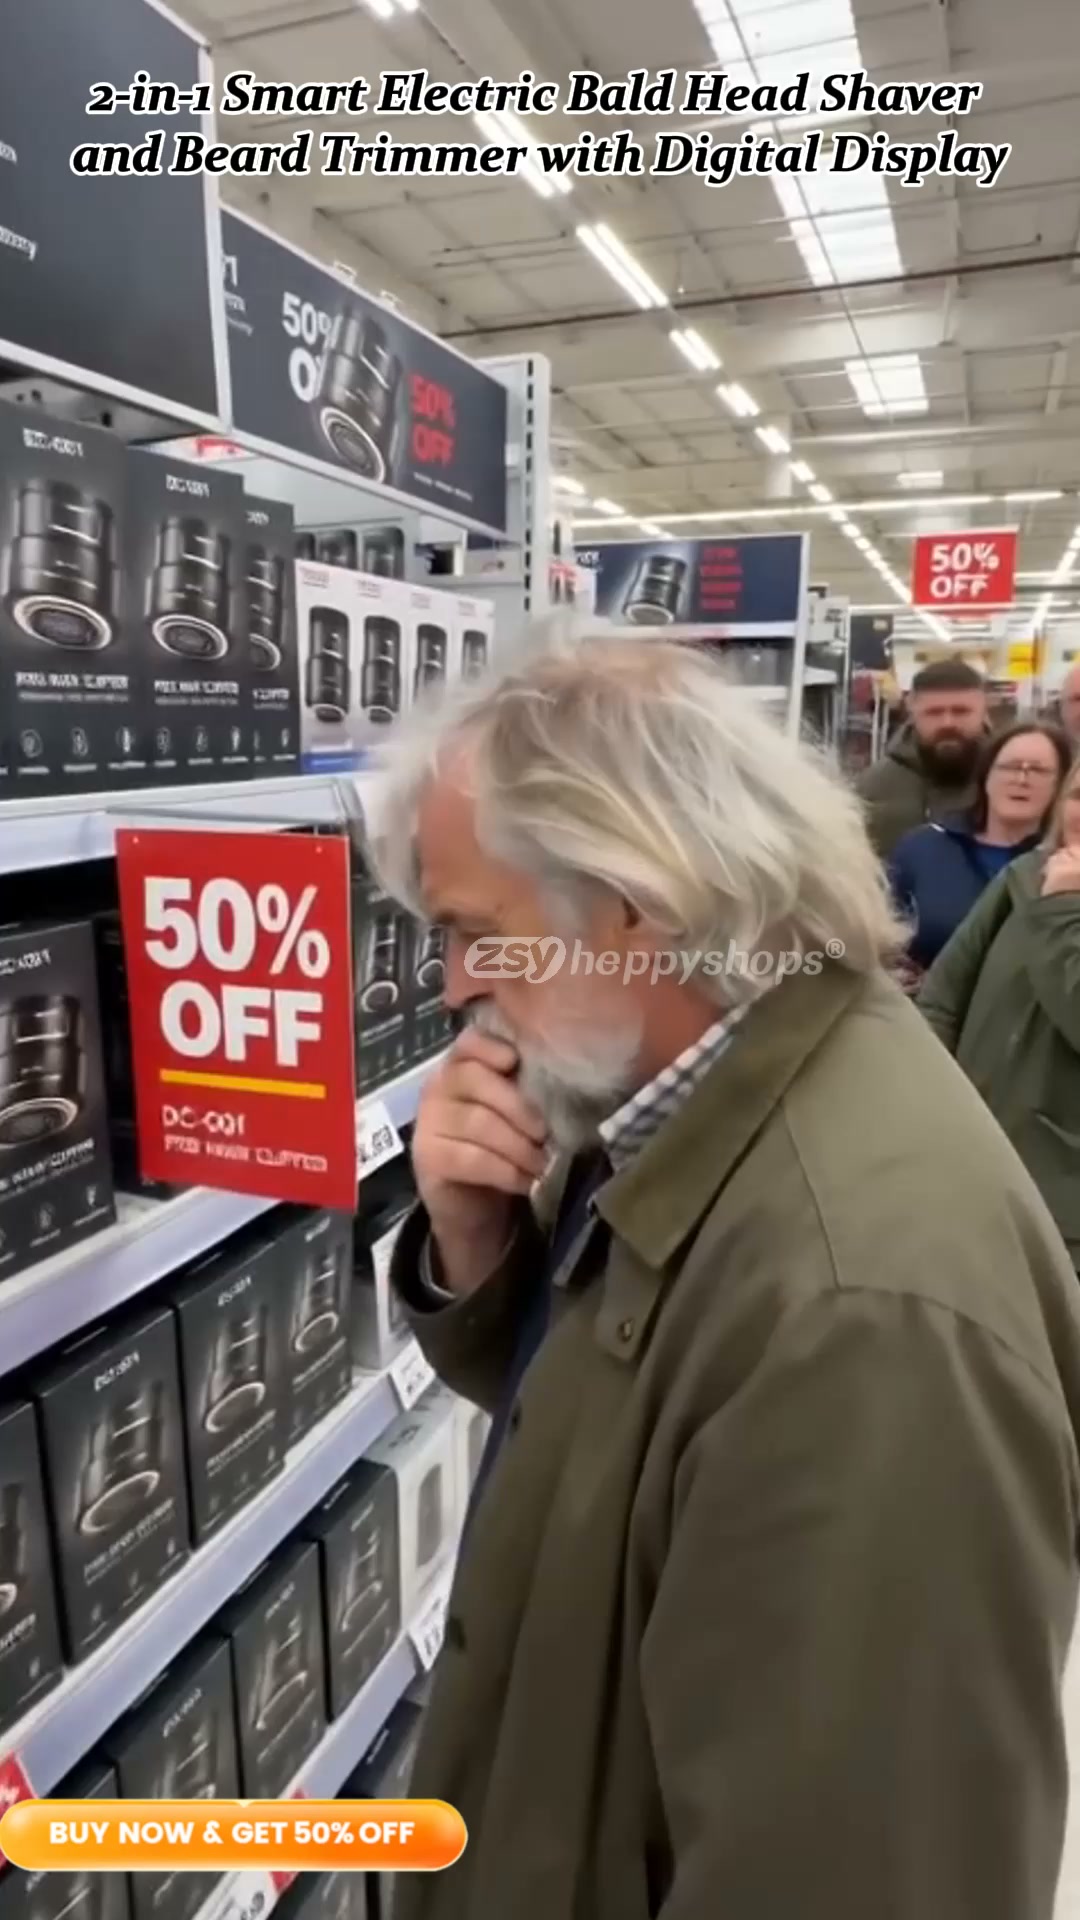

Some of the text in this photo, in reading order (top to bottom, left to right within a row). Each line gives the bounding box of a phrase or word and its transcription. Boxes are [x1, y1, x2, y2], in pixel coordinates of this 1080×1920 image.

[930, 542, 1000, 573] 50%
[930, 573, 989, 599] OFF
[144, 876, 331, 978] 50%
[160, 979, 324, 1067] OFF
